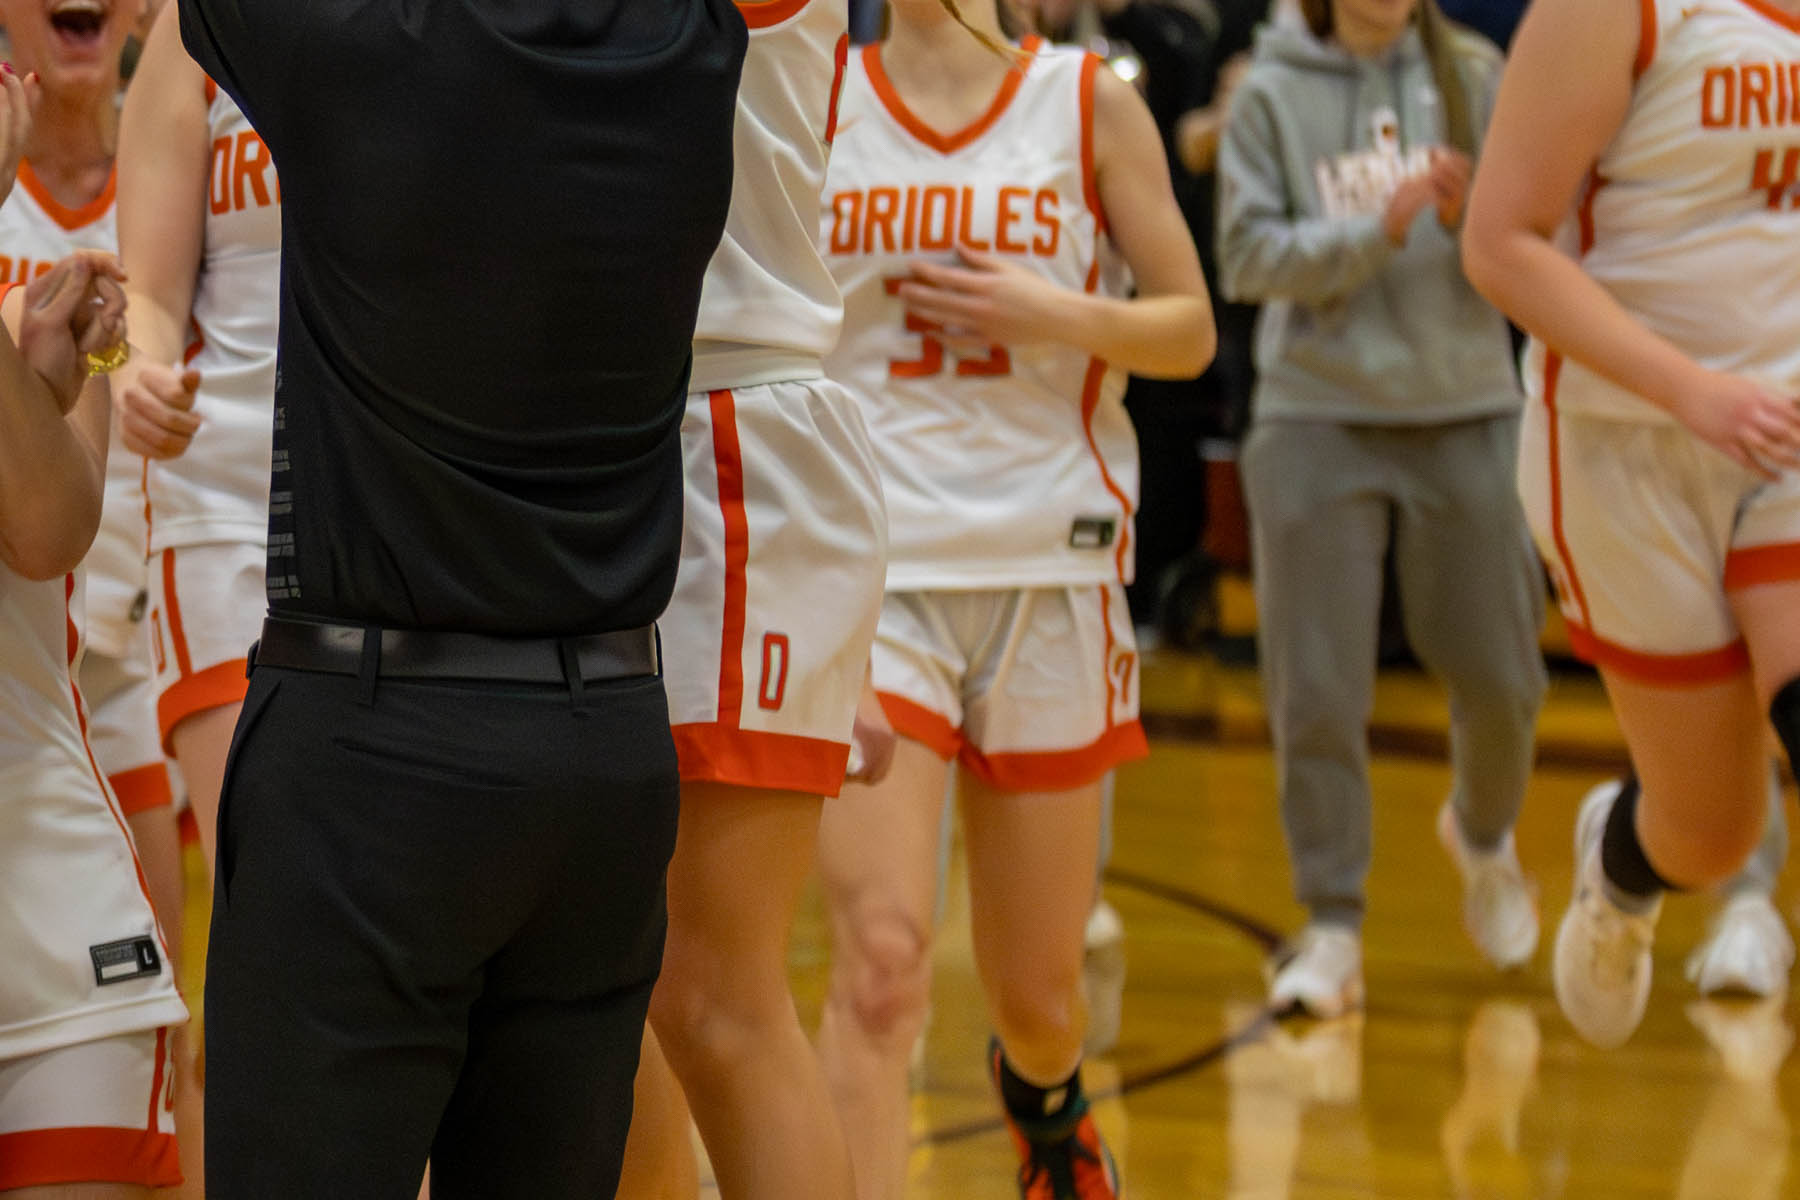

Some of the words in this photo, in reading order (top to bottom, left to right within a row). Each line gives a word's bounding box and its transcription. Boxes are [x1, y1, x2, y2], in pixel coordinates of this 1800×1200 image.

[1701, 65, 1800, 128] ORI
[209, 130, 281, 216] OR
[830, 185, 1060, 258] ORIOLES
